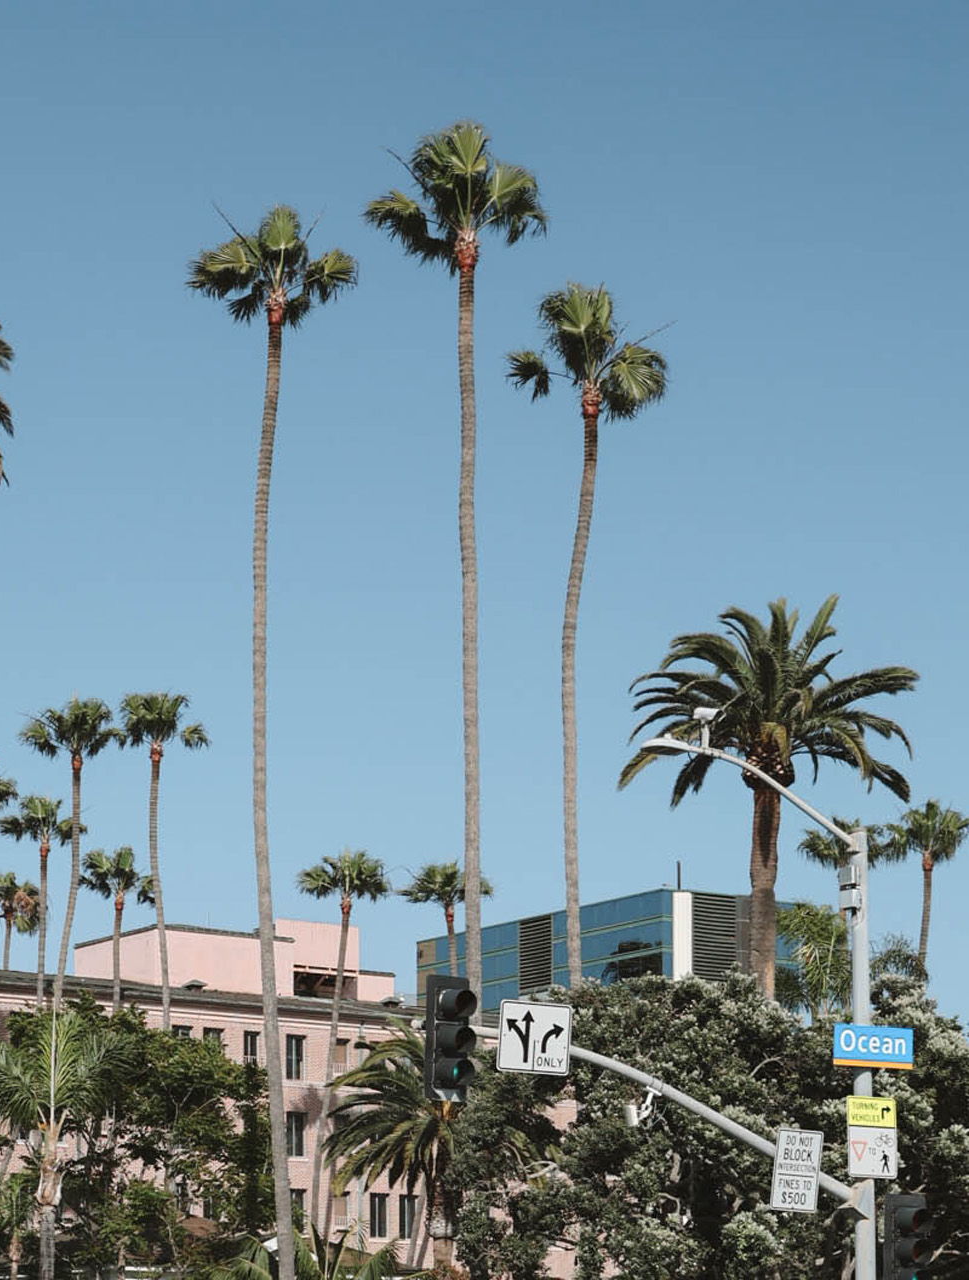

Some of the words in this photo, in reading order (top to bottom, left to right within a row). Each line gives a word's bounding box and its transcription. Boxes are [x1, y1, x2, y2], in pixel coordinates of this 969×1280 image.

[840, 1029, 906, 1055] Ocean
[536, 1056, 563, 1068] ONLY
[852, 1102, 879, 1110] TURNING
[786, 1135, 796, 1146] DO
[799, 1137, 814, 1147] NOT
[783, 1148, 814, 1163] BLOCK
[778, 1178, 800, 1190] FINES
[803, 1181, 812, 1190] TO
[781, 1191, 806, 1205] $500
